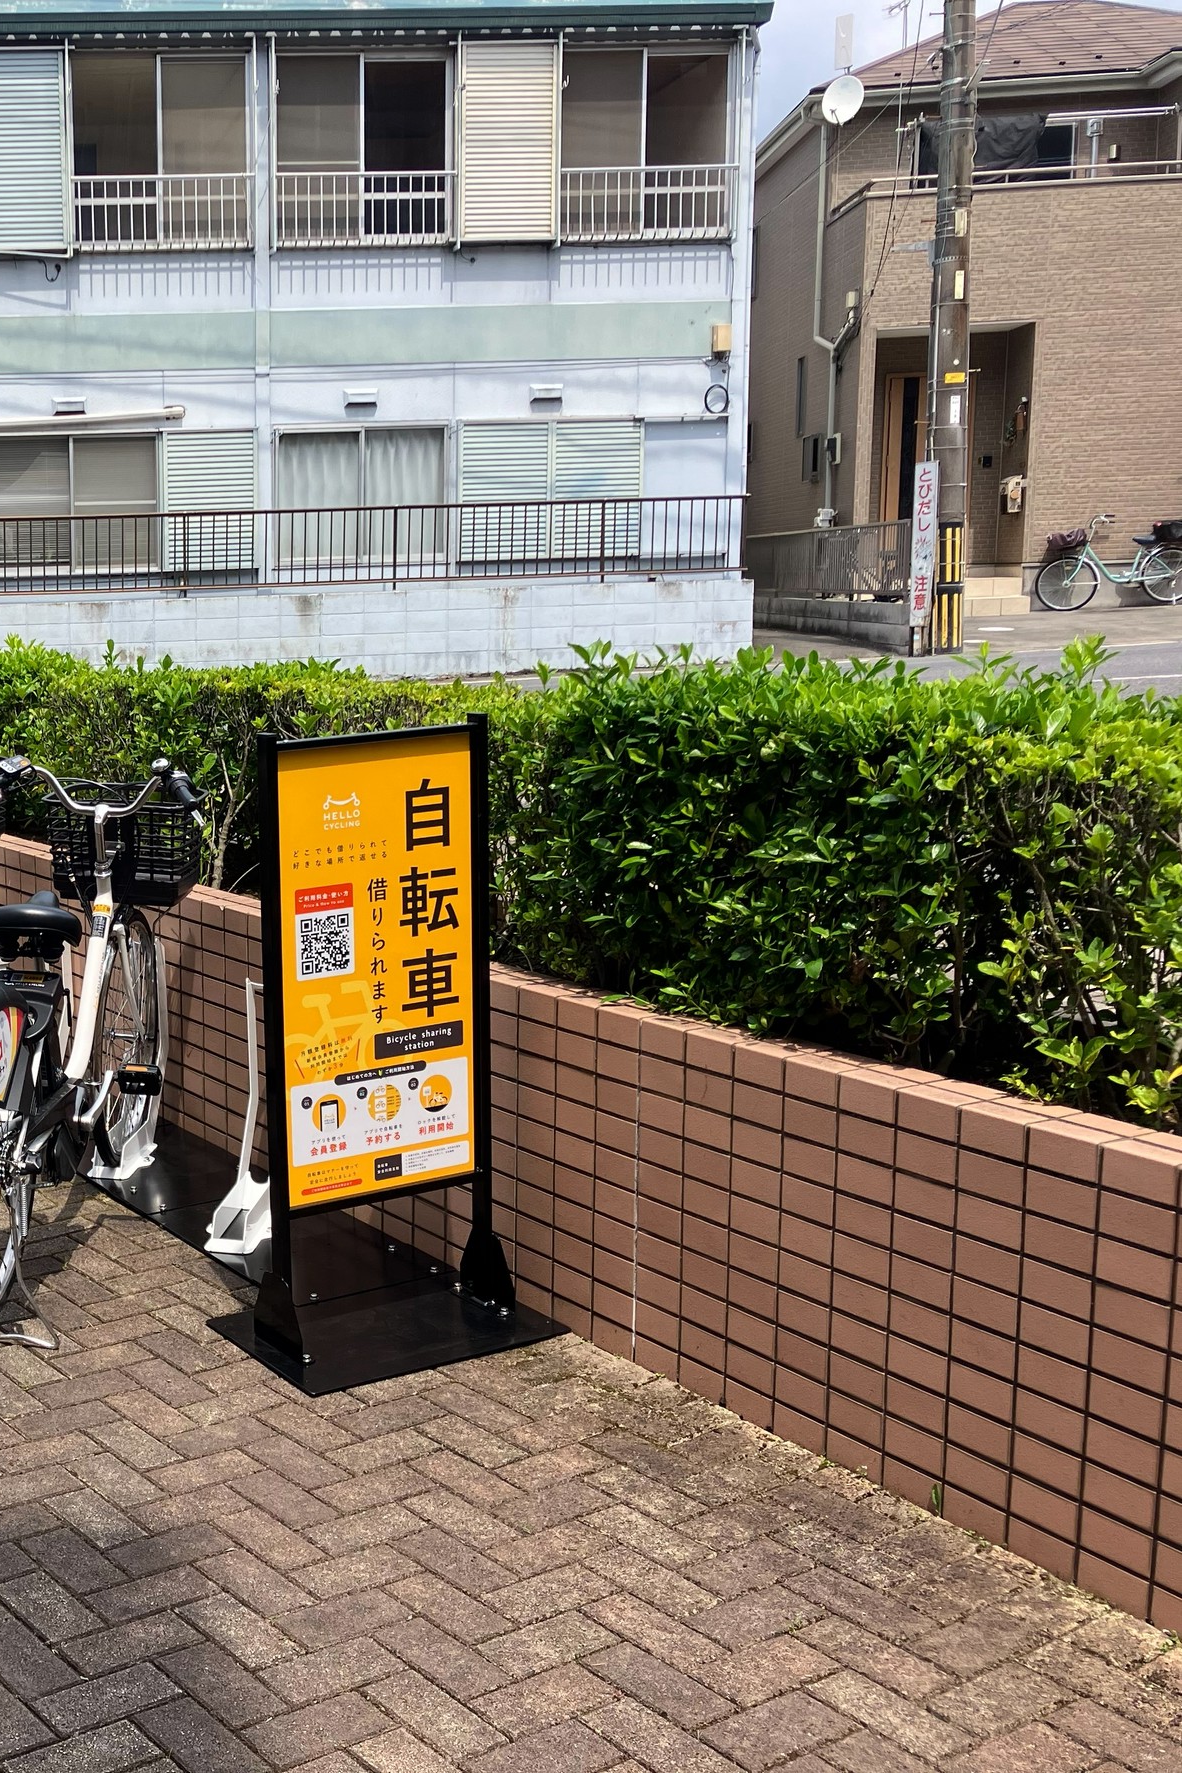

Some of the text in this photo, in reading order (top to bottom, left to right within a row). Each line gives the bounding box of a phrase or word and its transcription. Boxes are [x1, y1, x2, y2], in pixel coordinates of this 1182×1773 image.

[913, 468, 933, 611] とびだし 注意
[323, 809, 361, 821] HELLO
[323, 820, 361, 831] CYCLING
[293, 839, 387, 858] どこでも借りられて
[292, 851, 387, 870] 好きな場所で返せる
[399, 778, 460, 1018] 自転車
[367, 877, 388, 1024] 借りられます
[386, 1027, 452, 1045] Bicycle sharing
[404, 1040, 435, 1051] station
[418, 1121, 454, 1136] 利用開始
[365, 1131, 401, 1146] 予約する
[310, 1141, 347, 1157] 会員登録
